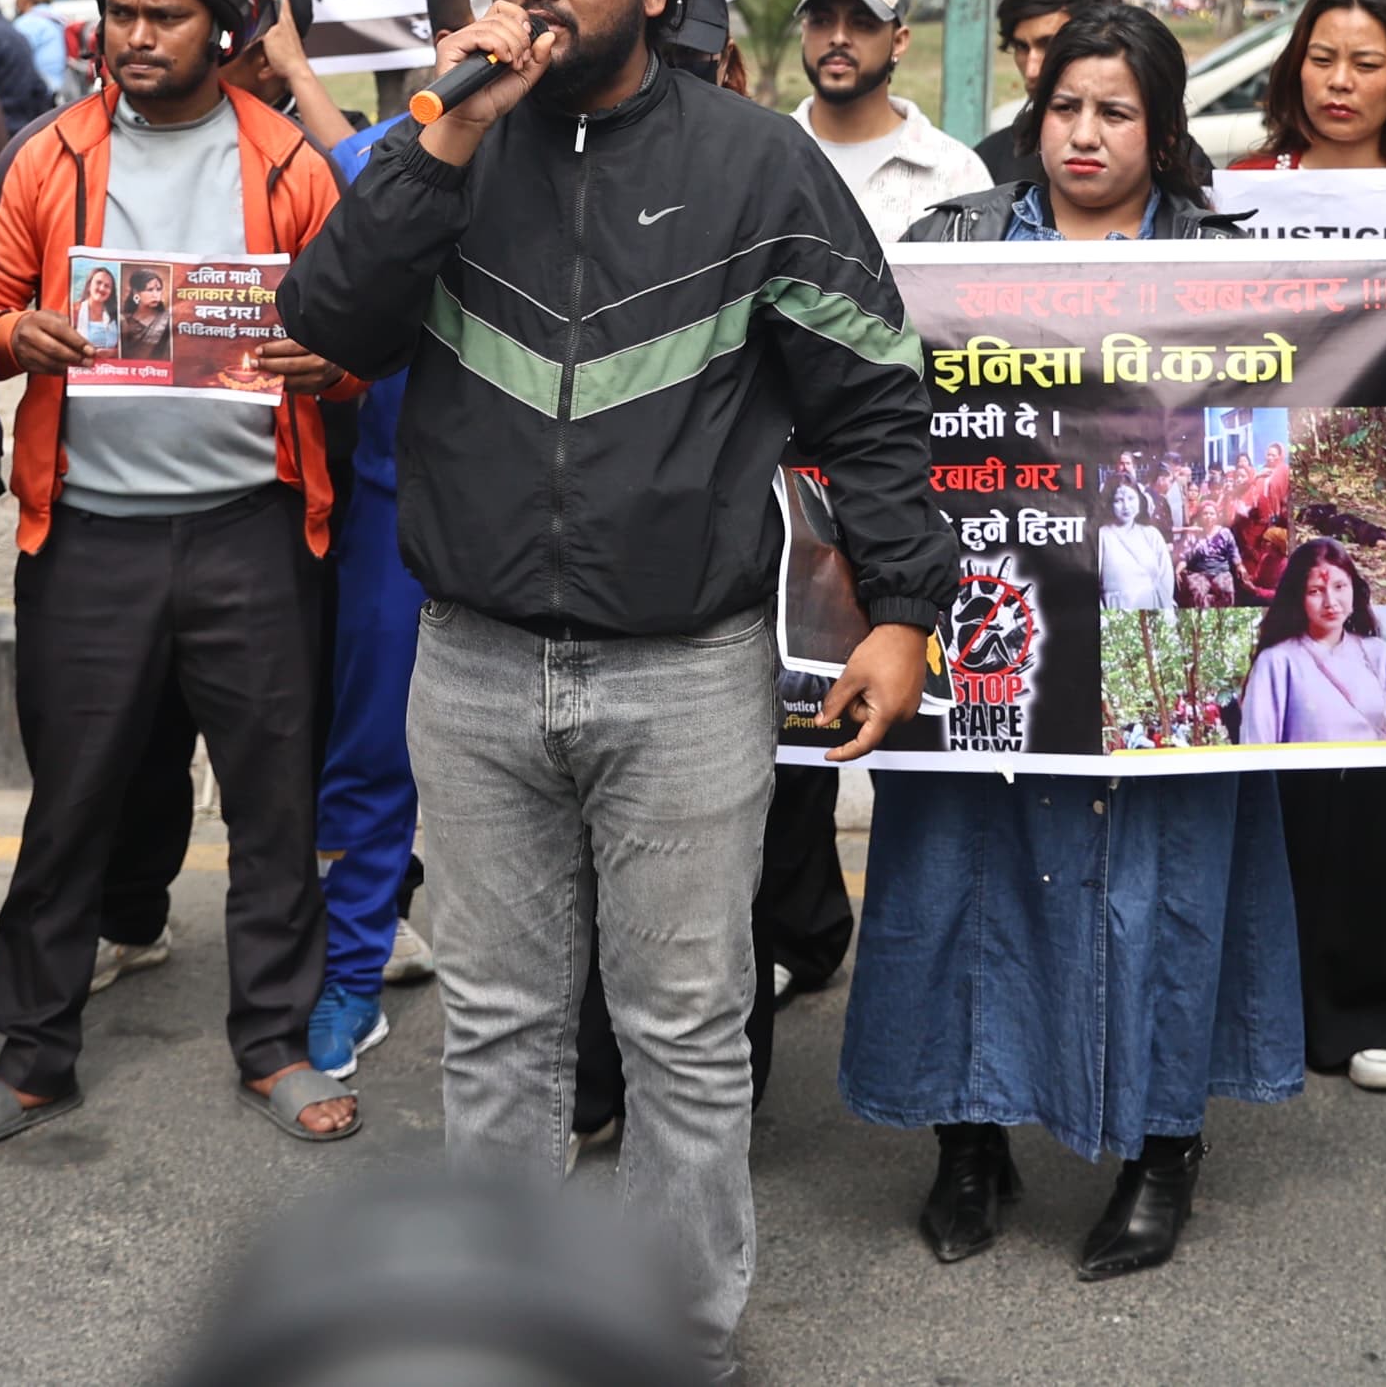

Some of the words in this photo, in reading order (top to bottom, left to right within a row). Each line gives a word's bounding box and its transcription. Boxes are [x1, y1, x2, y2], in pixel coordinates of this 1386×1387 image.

[187, 267, 226, 284] दलित
[229, 267, 261, 285] माथी
[954, 281, 1126, 318] खबरदार
[1174, 277, 1347, 314] खबरदार
[932, 333, 1085, 394] इनिसा
[1100, 332, 1297, 385] वि.क.को
[929, 403, 1006, 439] फाँसी
[1015, 402, 1039, 439] दे
[1015, 464, 1061, 492] गर
[961, 509, 1009, 551] हुने
[1018, 508, 1086, 546] हिंसा
[953, 673, 1024, 704] STOP
[950, 704, 1023, 738] RAPE
[950, 737, 1023, 752] NOW
